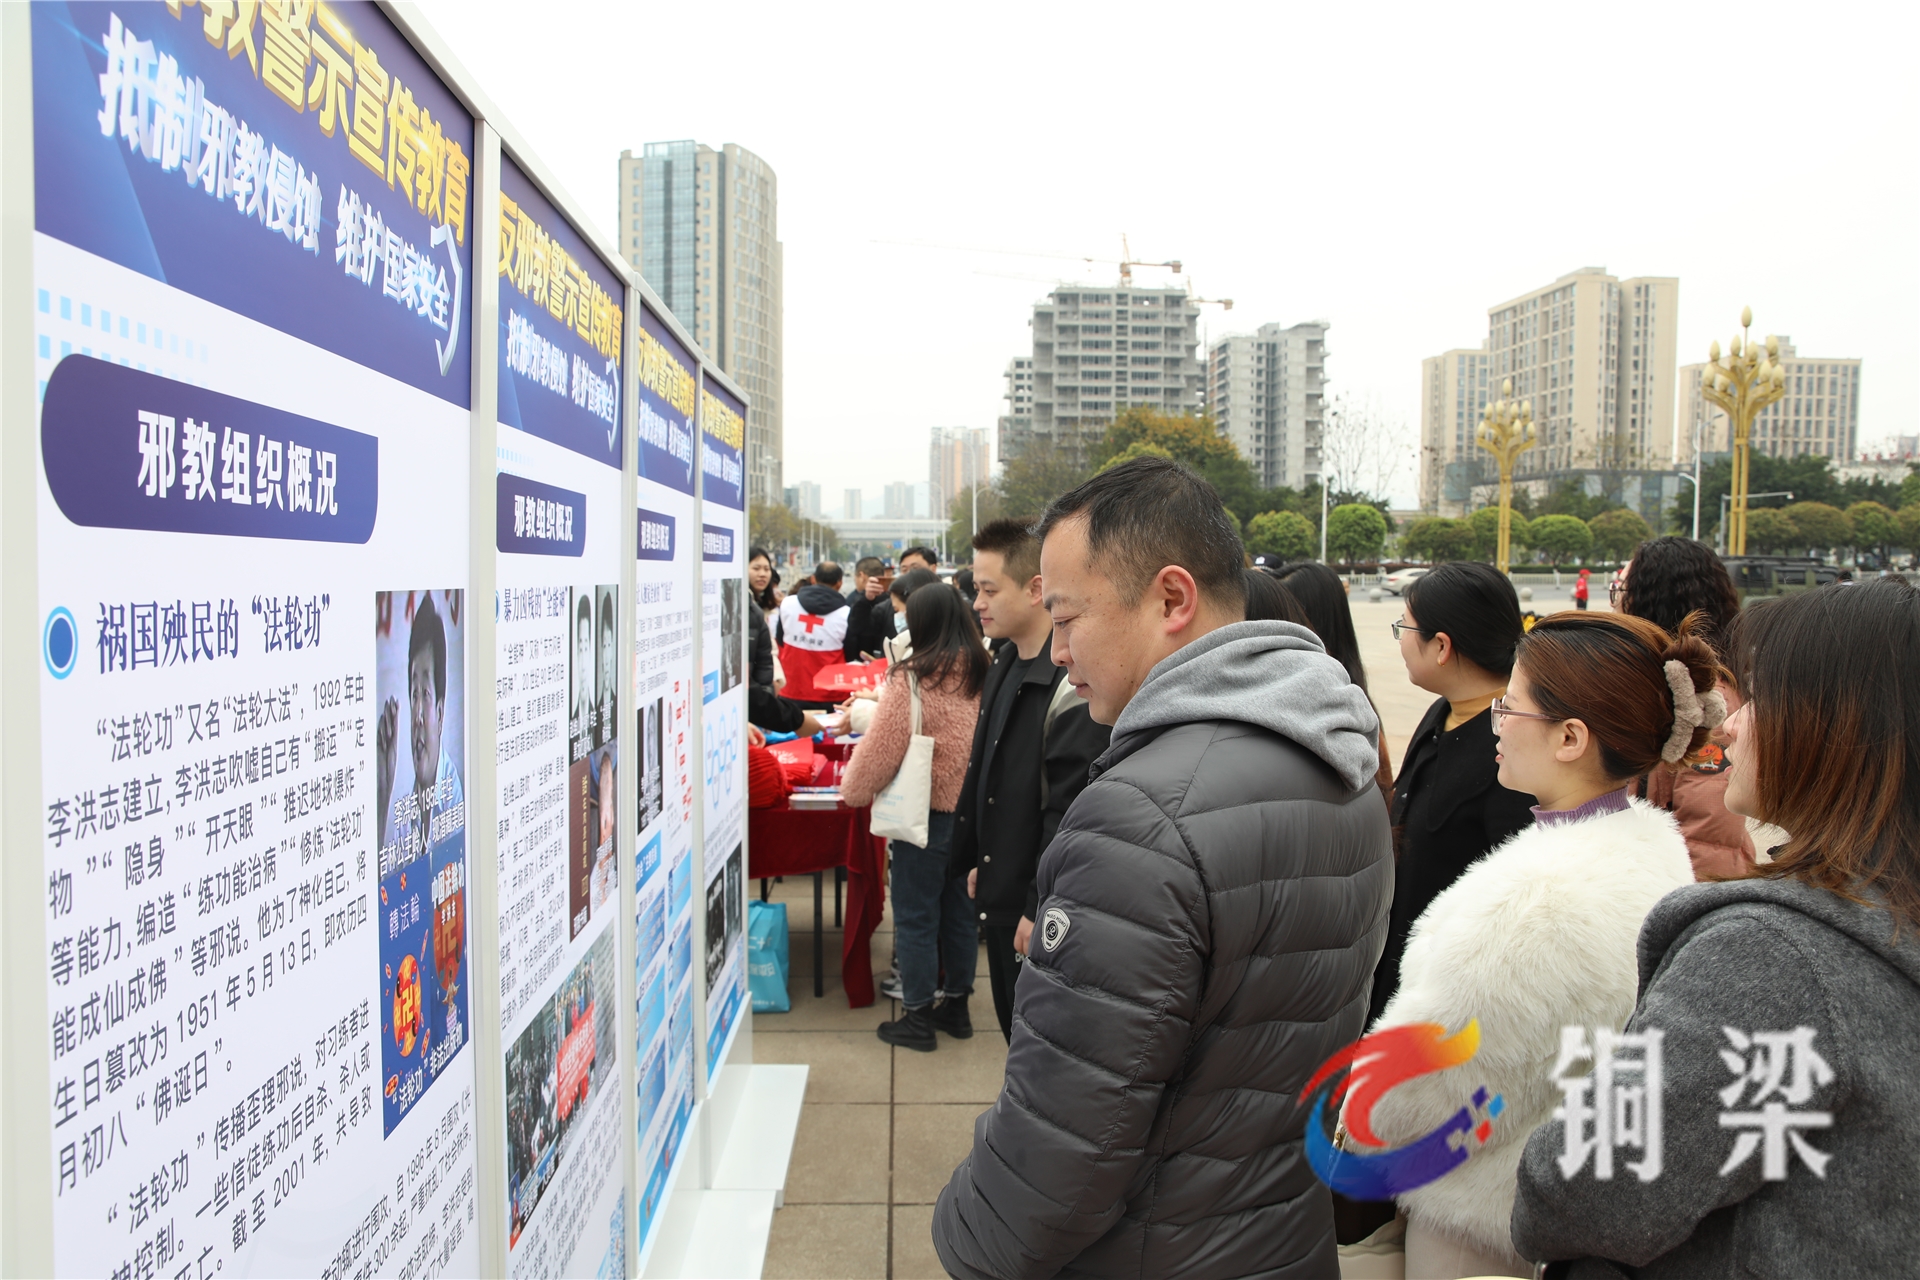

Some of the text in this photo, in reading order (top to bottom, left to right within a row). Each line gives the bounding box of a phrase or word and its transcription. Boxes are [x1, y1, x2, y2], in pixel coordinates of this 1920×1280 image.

[97, 12, 452, 331] 抵制邪教侵蚀 维护国家安全
[137, 409, 339, 516] 邪教组织概况
[513, 493, 574, 542] 邪教组织概况
